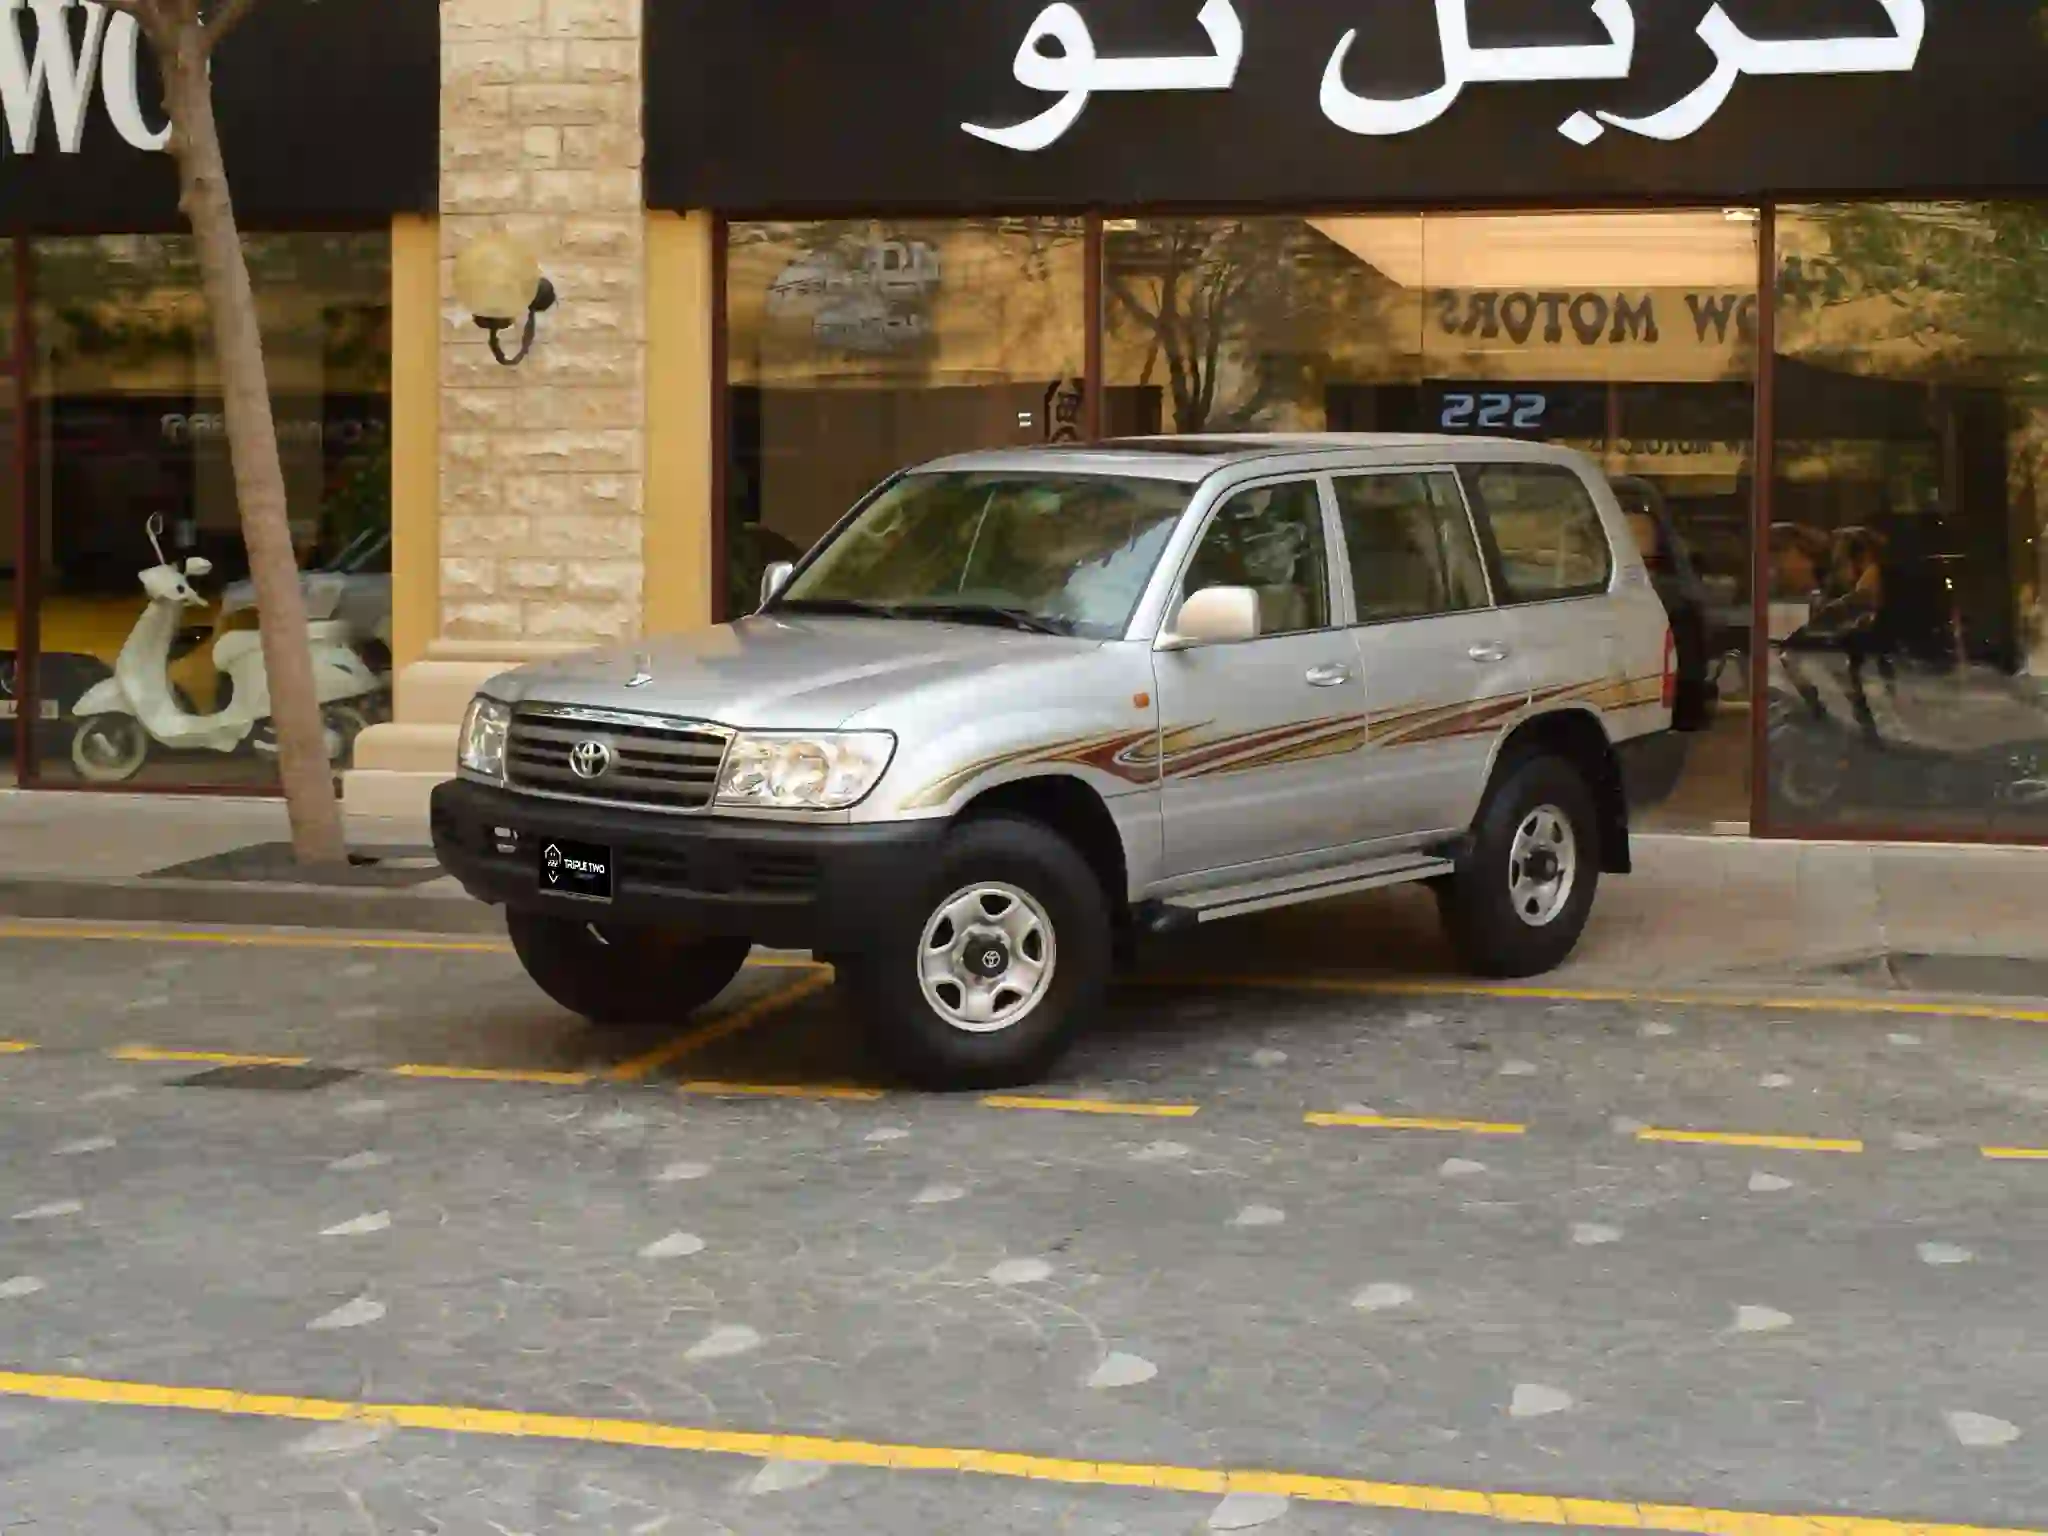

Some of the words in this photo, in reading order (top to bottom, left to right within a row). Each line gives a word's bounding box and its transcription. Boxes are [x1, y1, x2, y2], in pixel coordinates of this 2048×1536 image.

[1441, 393, 1546, 428] 222
[564, 859, 588, 872] TRIPLE
[588, 862, 605, 874] TWO
